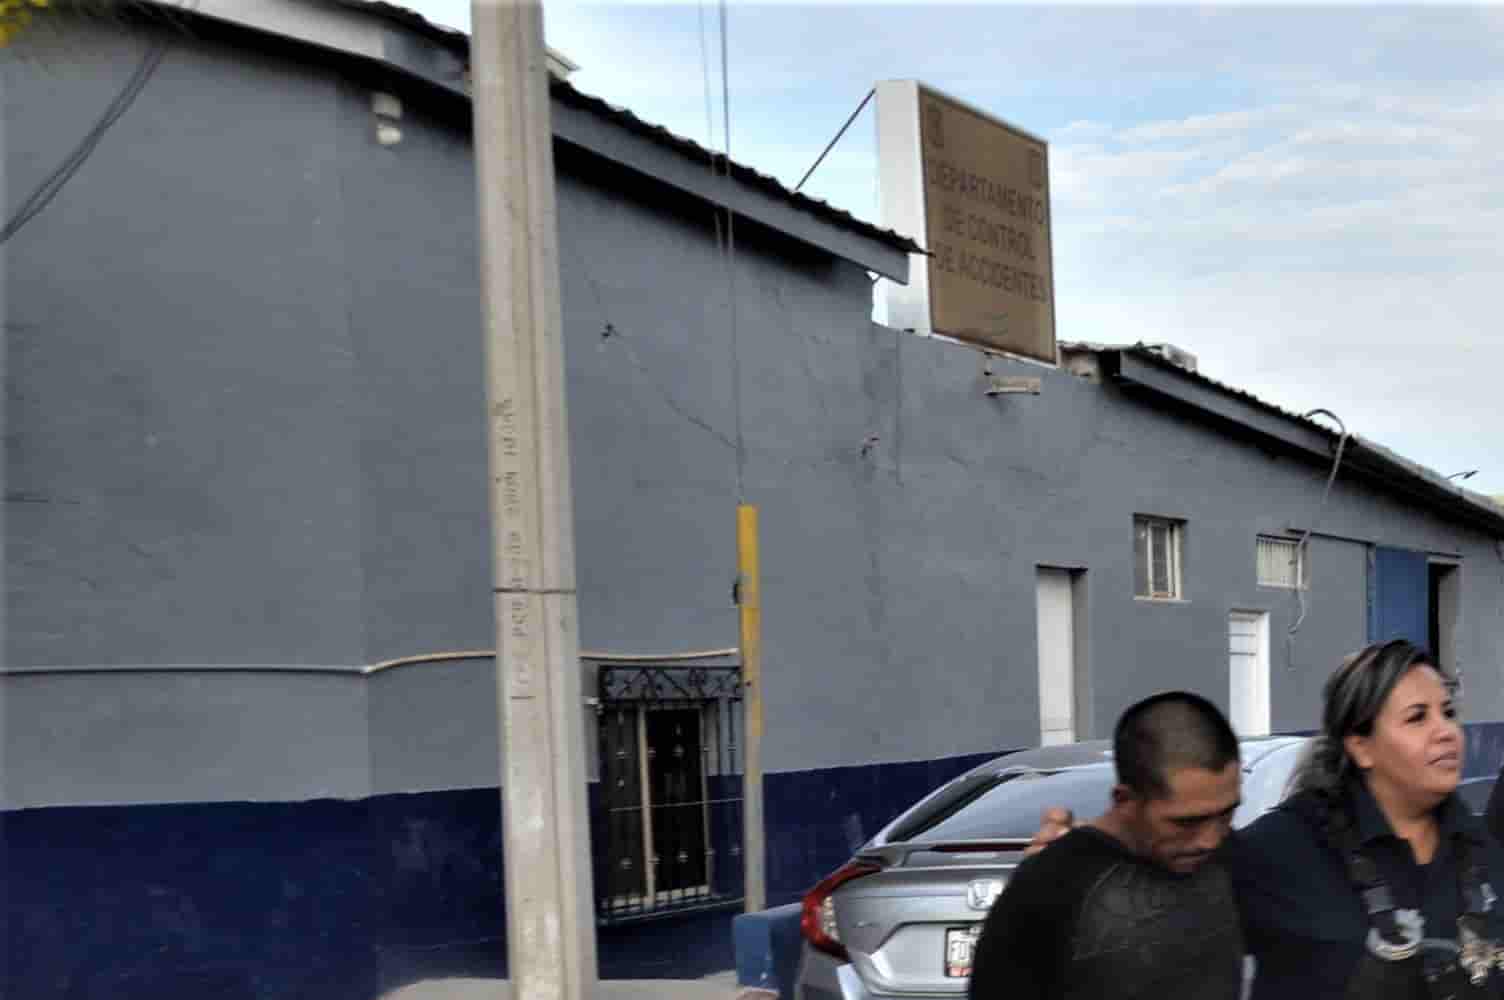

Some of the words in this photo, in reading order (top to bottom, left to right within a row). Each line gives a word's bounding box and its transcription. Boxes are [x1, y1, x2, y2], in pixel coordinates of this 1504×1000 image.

[928, 159, 1045, 225] DEPARTAMENTO
[966, 212, 1037, 260] CONTROL
[959, 249, 1048, 302] ACCIDENTES
